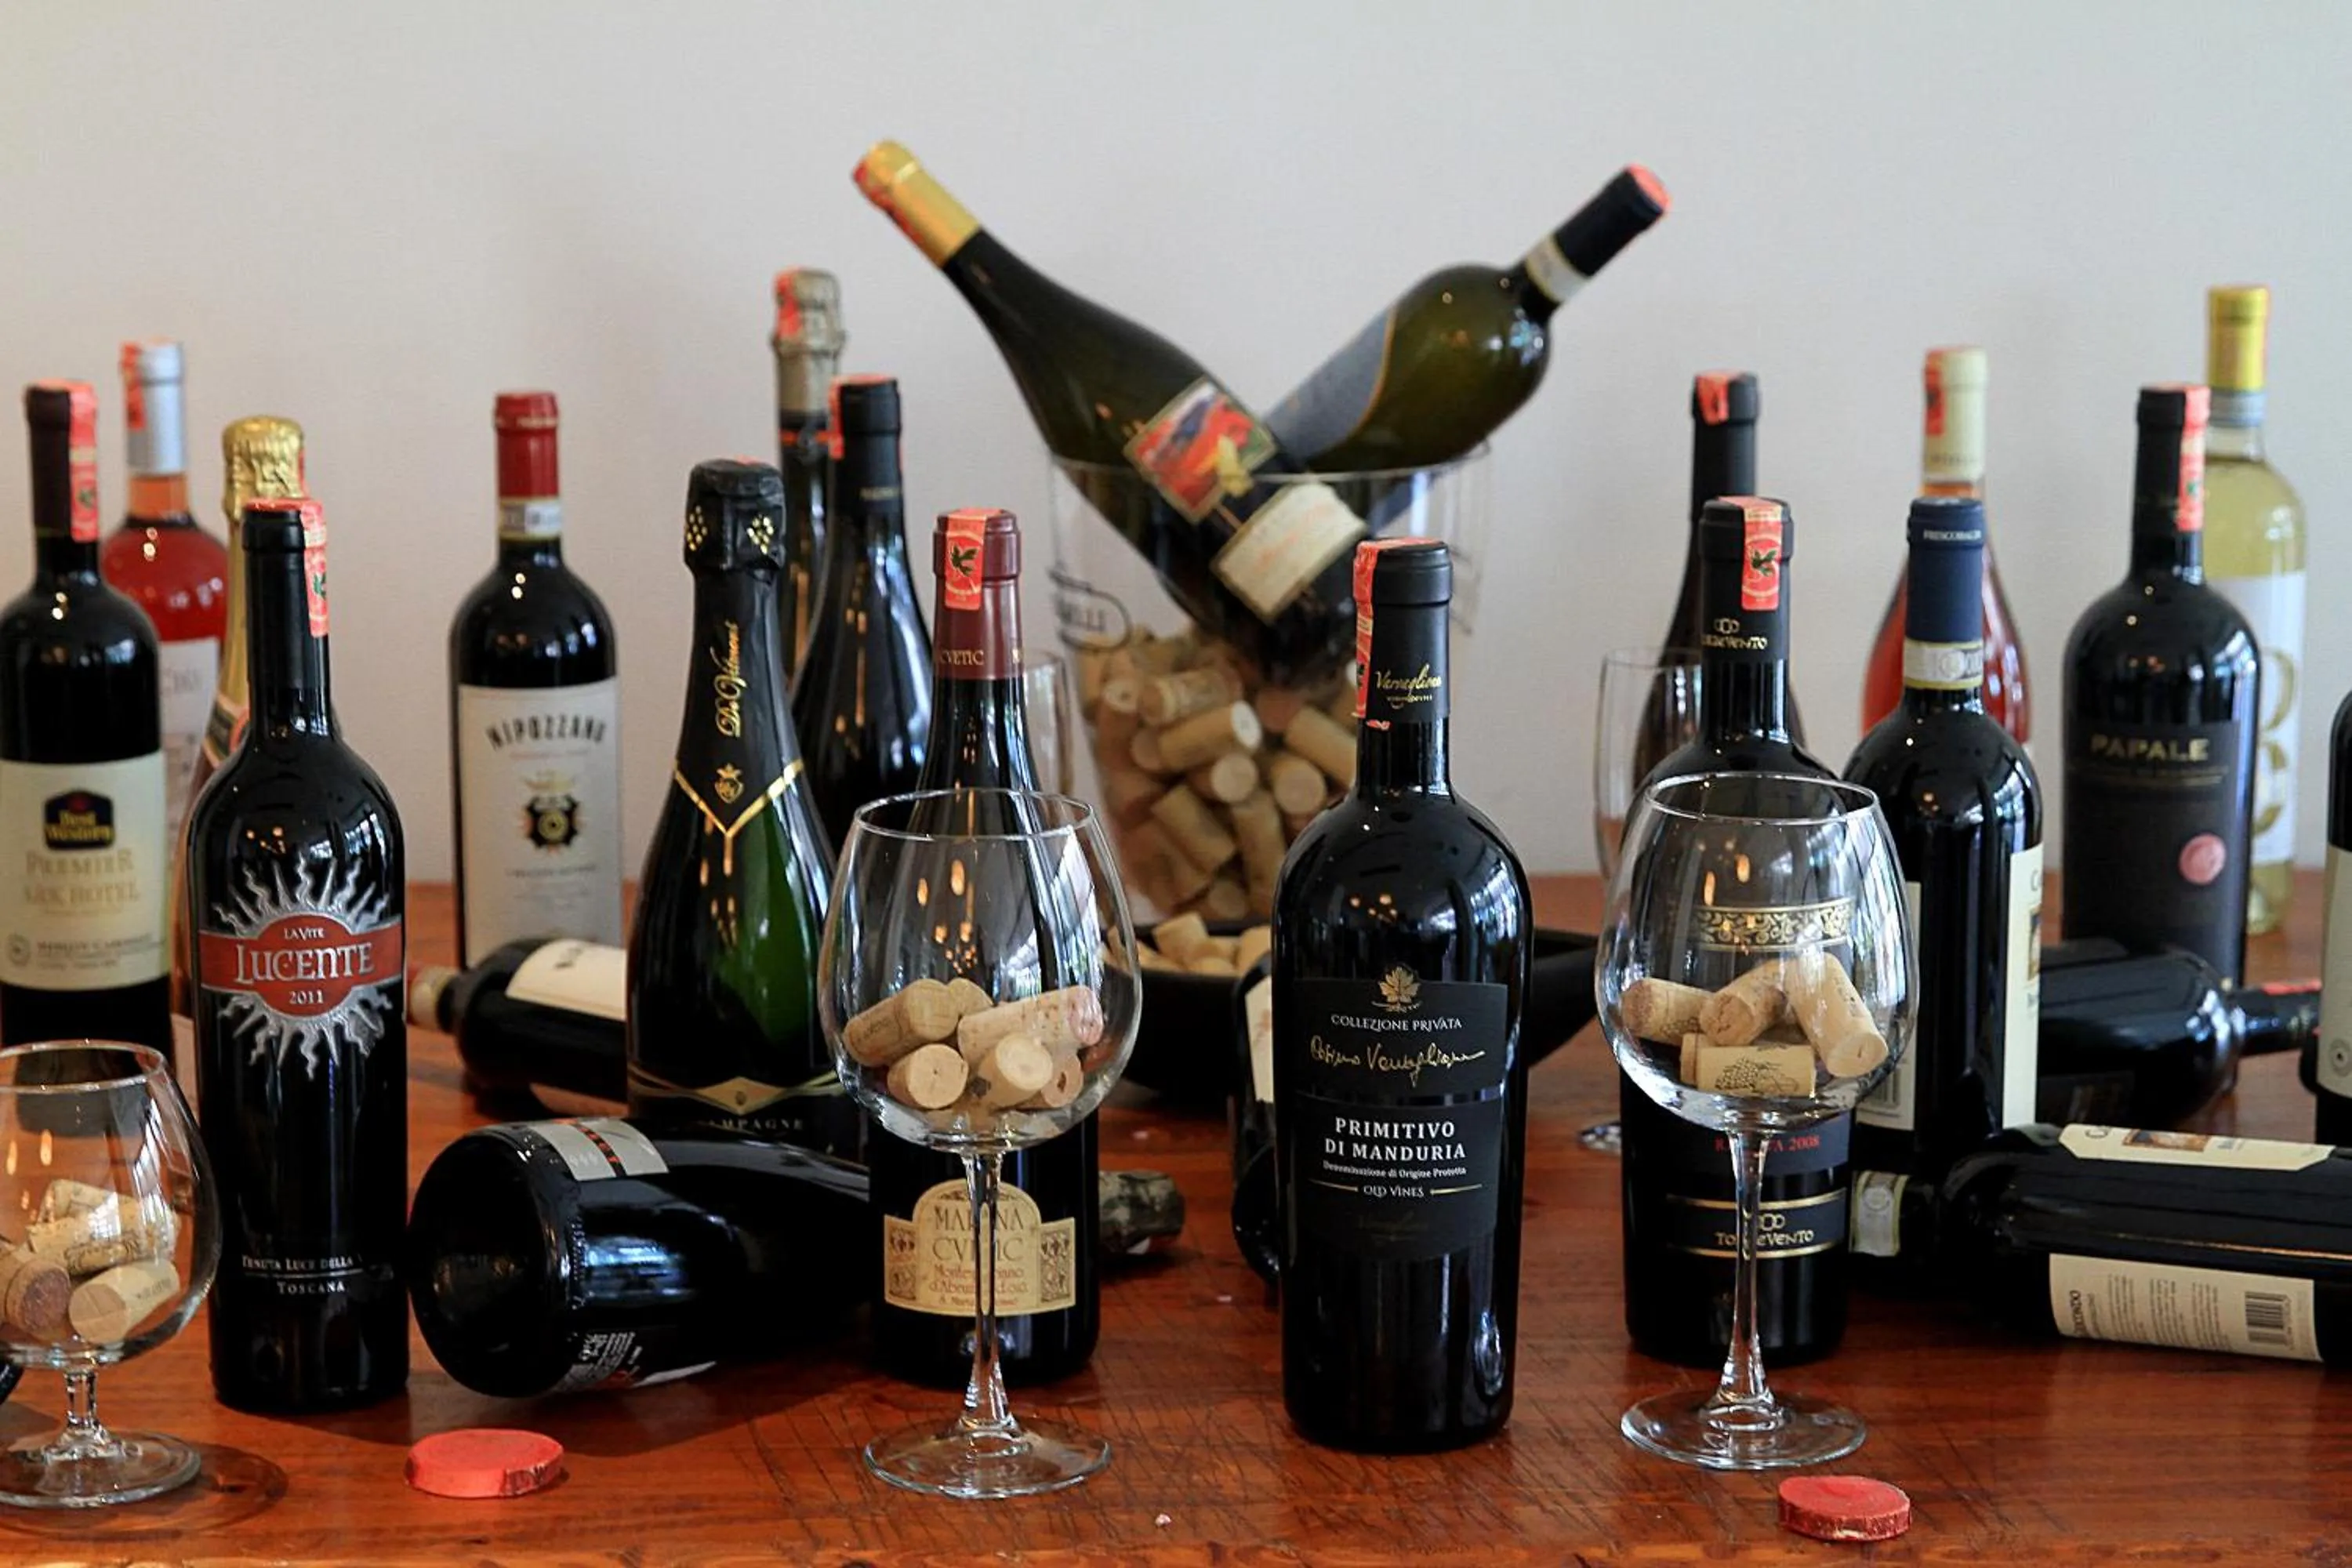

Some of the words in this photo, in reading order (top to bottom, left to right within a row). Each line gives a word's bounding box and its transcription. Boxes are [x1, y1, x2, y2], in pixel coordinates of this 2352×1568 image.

[2090, 734, 2210, 761] PAPALE
[236, 942, 375, 985] LUCENTE
[289, 989, 324, 1004] 2011
[1330, 1014, 1409, 1033] COLLEZIONE
[1413, 1016, 1463, 1033] PRIVATA
[1335, 1116, 1455, 1140] PRIMITIVO
[1325, 1138, 1345, 1156] DI
[1352, 1142, 1466, 1162] MANDURIA
[1399, 1169, 1432, 1180] Origine
[1363, 1185, 1388, 1198] OLD
[1389, 1185, 1424, 1198] VINES
[934, 1205, 1024, 1232] MANA
[931, 1236, 1023, 1261] CVIC
[1714, 1229, 1815, 1247] TOEVENTO
[276, 1280, 346, 1294] TOSCANA
